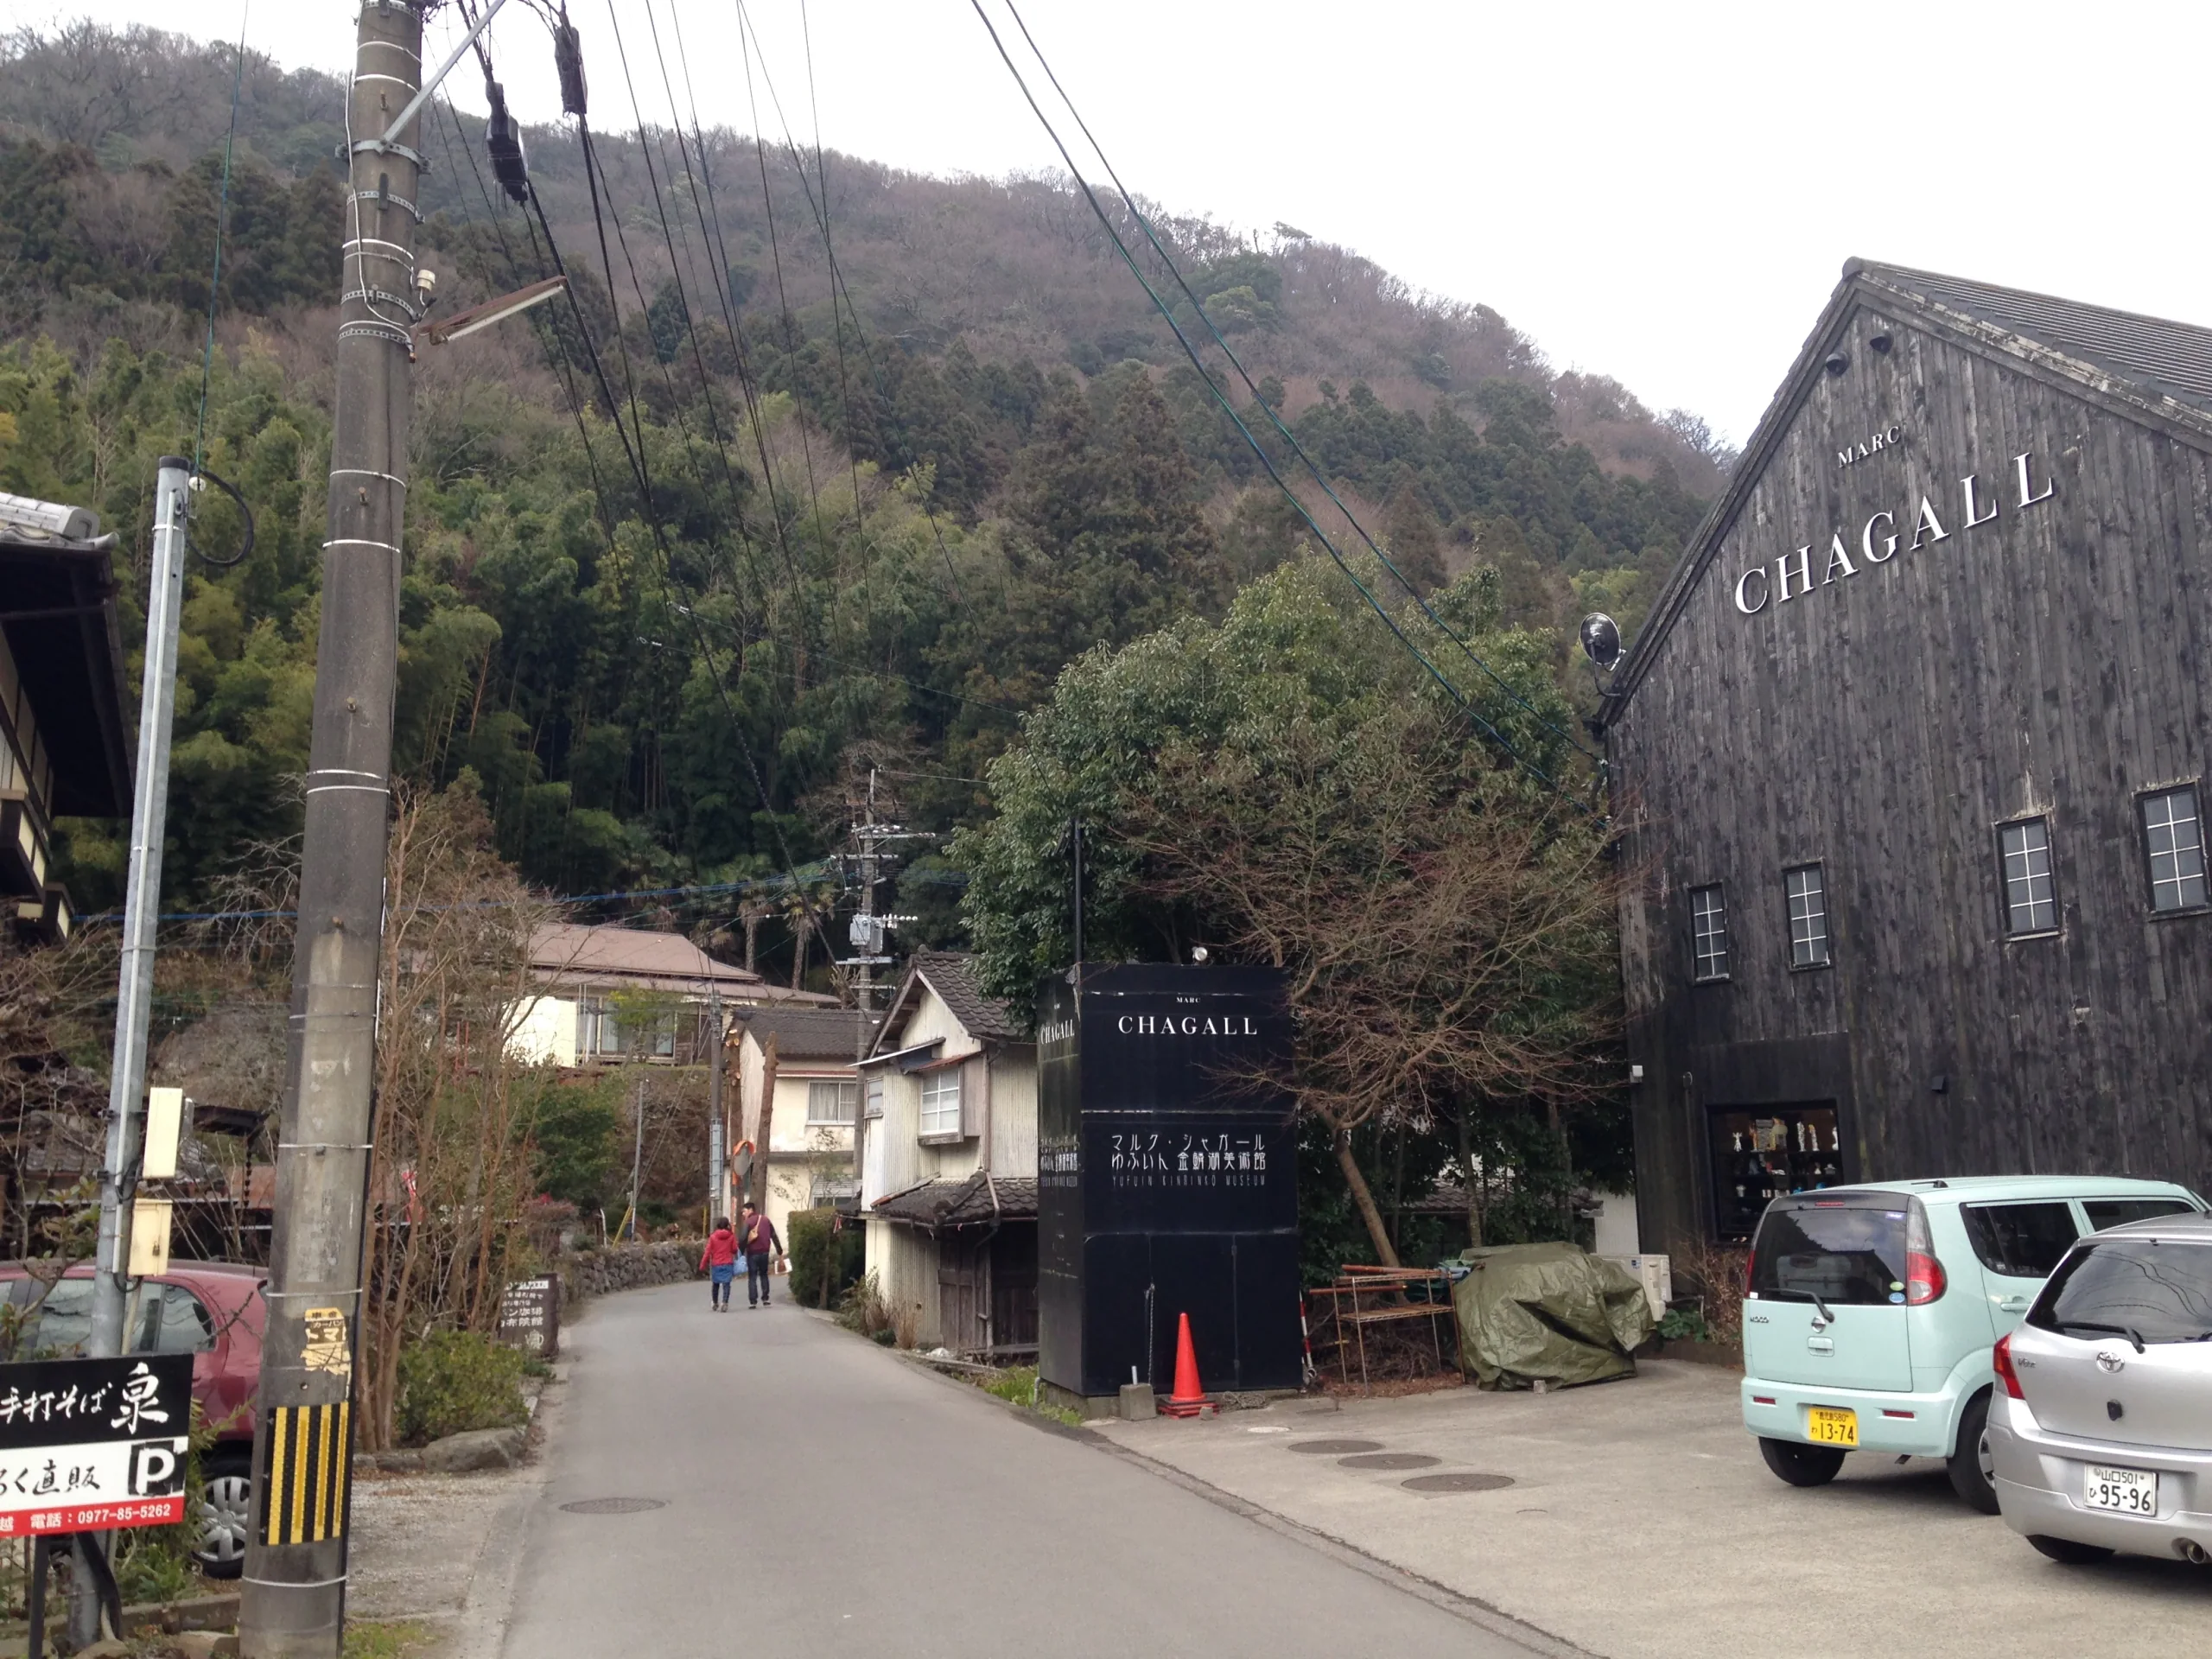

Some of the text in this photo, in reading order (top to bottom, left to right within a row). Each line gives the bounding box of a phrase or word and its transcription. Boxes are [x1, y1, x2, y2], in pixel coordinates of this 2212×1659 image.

[1838, 426, 1902, 468] MARC
[1735, 452, 2054, 614] CHAGALL
[1040, 1019, 1075, 1045] CHAGALL
[1118, 1015, 1257, 1035] CHAGALL
[1111, 1134, 1265, 1152] マルク・シャガール
[1112, 1175, 1153, 1186] YUFUIN
[1225, 1175, 1265, 1186] MUSEUM
[0, 1362, 169, 1434] 手打そば 泉
[1821, 1422, 1854, 1442] 13-74
[136, 1448, 175, 1495] P
[2101, 1471, 2138, 1484] 山口501
[2100, 1484, 2151, 1511] 95-96
[78, 1504, 171, 1524] 0977-85-5262
